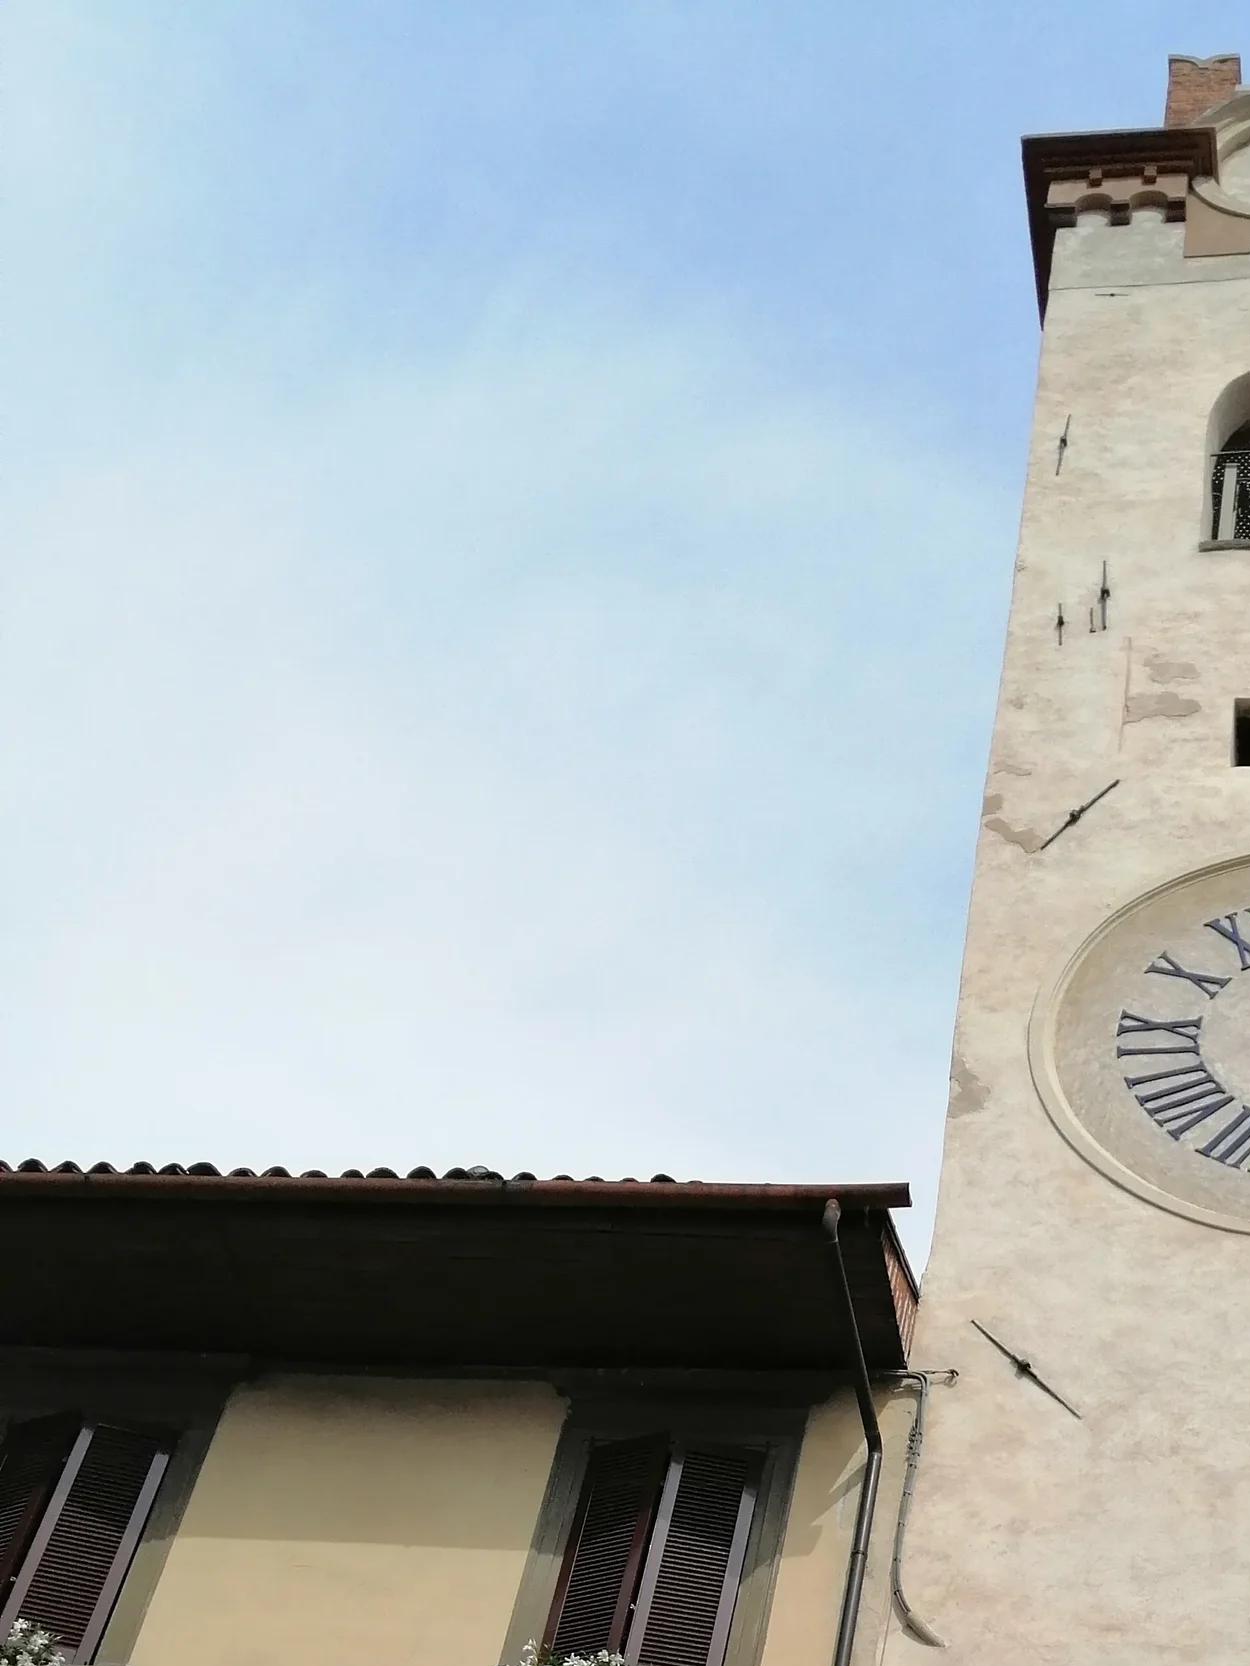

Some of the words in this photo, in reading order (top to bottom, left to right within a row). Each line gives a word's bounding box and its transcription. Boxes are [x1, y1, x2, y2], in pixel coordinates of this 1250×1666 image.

[1145, 951, 1232, 999] X
[1117, 1009, 1203, 1058] IX
[1124, 1062, 1236, 1140] VIII
